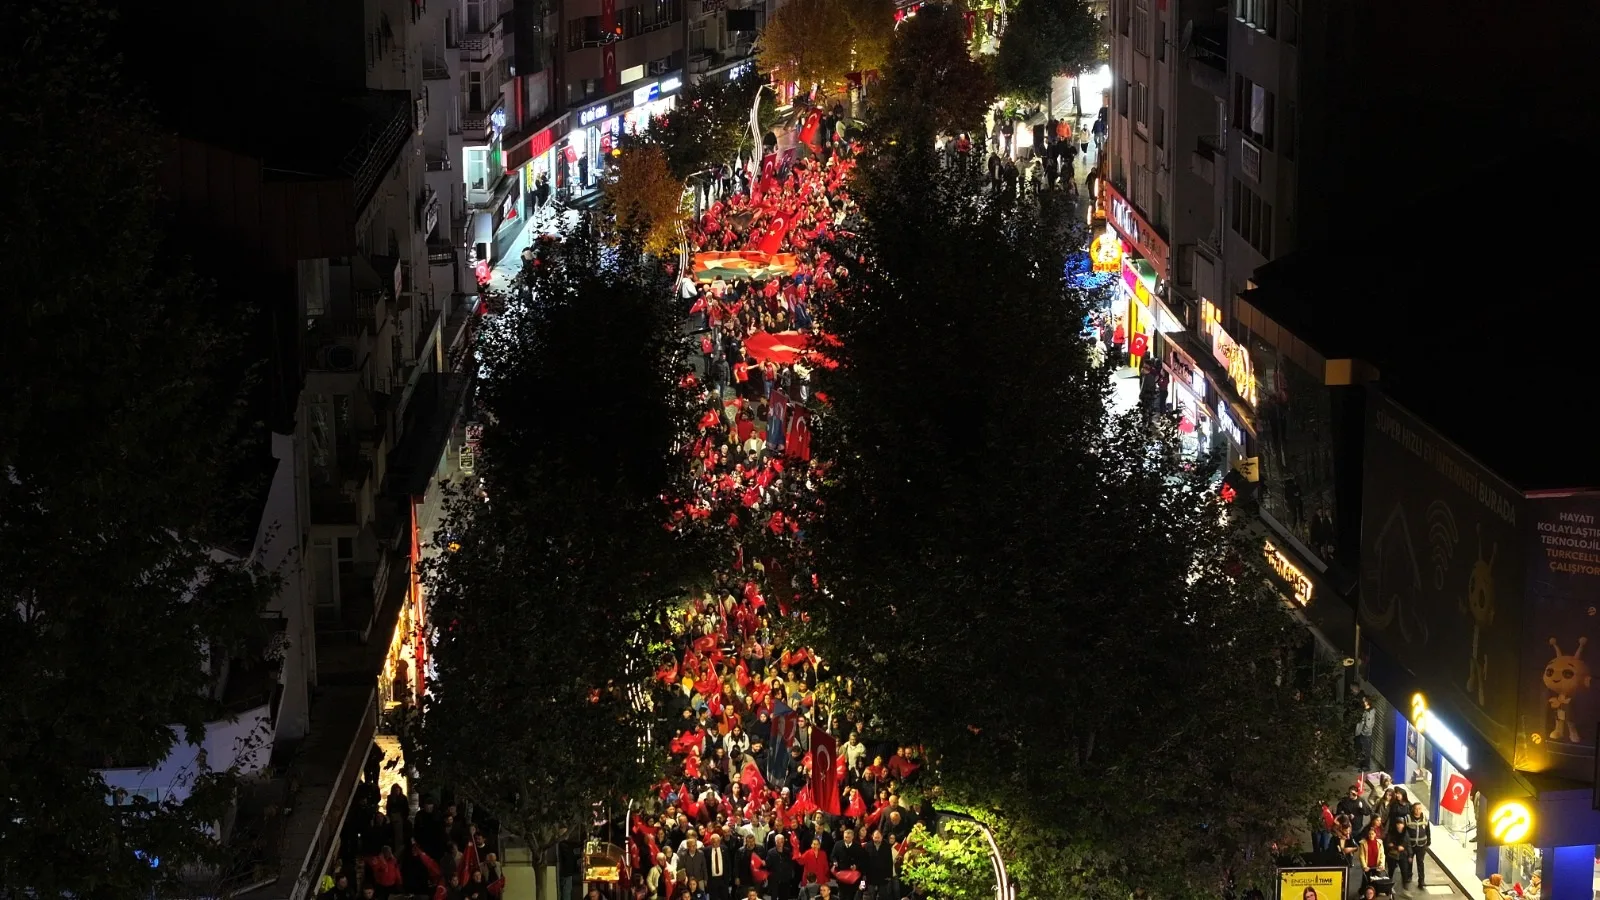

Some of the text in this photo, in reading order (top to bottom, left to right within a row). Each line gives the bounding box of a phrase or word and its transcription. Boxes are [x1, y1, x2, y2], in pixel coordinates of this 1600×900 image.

[1375, 409, 1400, 442] SÜPER
[1402, 425, 1422, 458] HIZLI
[1436, 445, 1478, 498] İNTERNETİ
[1479, 482, 1516, 527] BURADA
[1559, 512, 1594, 525] HAYATI
[1549, 561, 1600, 576] ÇALIŞIYOR
